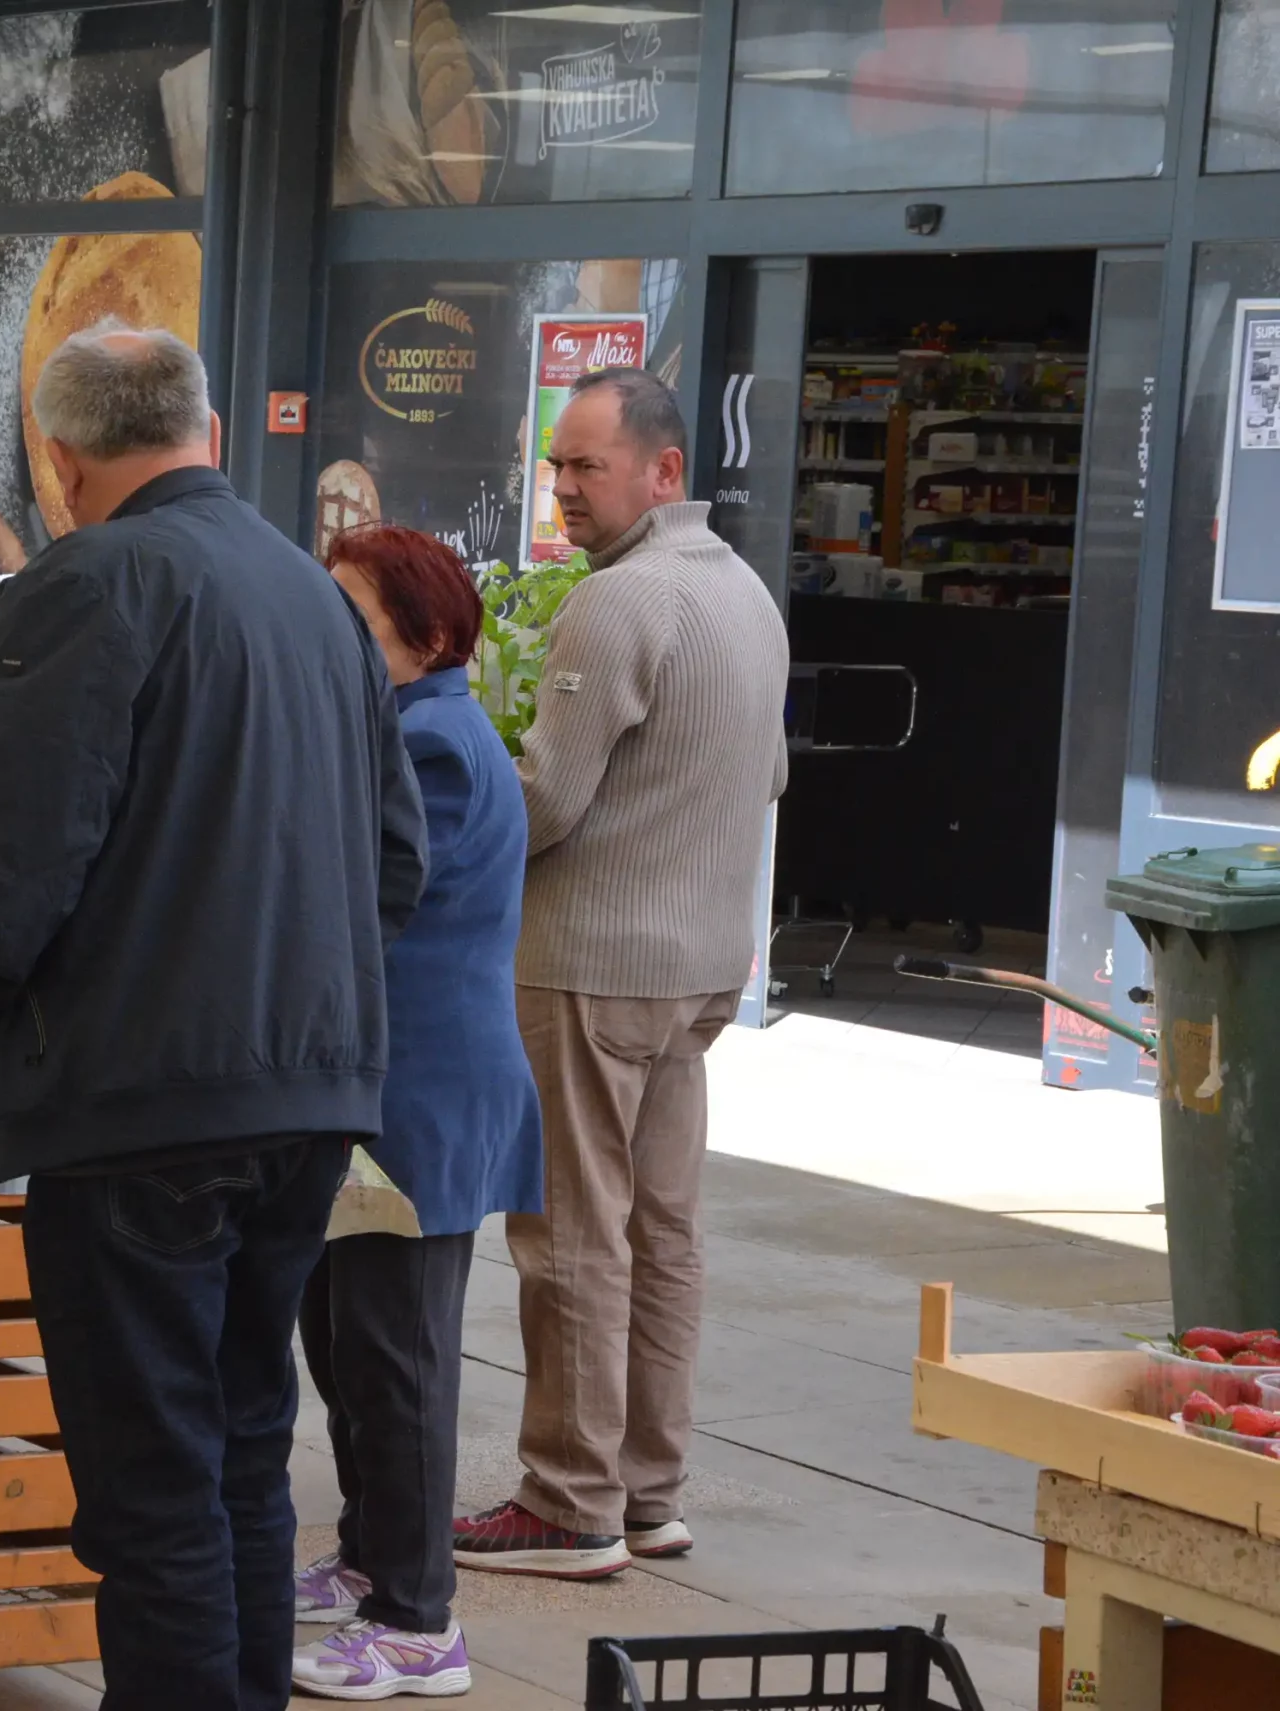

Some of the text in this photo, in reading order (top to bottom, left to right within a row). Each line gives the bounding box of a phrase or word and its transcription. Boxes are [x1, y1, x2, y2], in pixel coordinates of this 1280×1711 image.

[548, 52, 616, 93] VRHUNSKA
[549, 76, 650, 138] KVALITETA
[374, 342, 478, 370] ČAKOVEČKI
[586, 332, 638, 368] Maxi
[384, 372, 464, 394] MLINOVI
[408, 409, 436, 423] 1893
